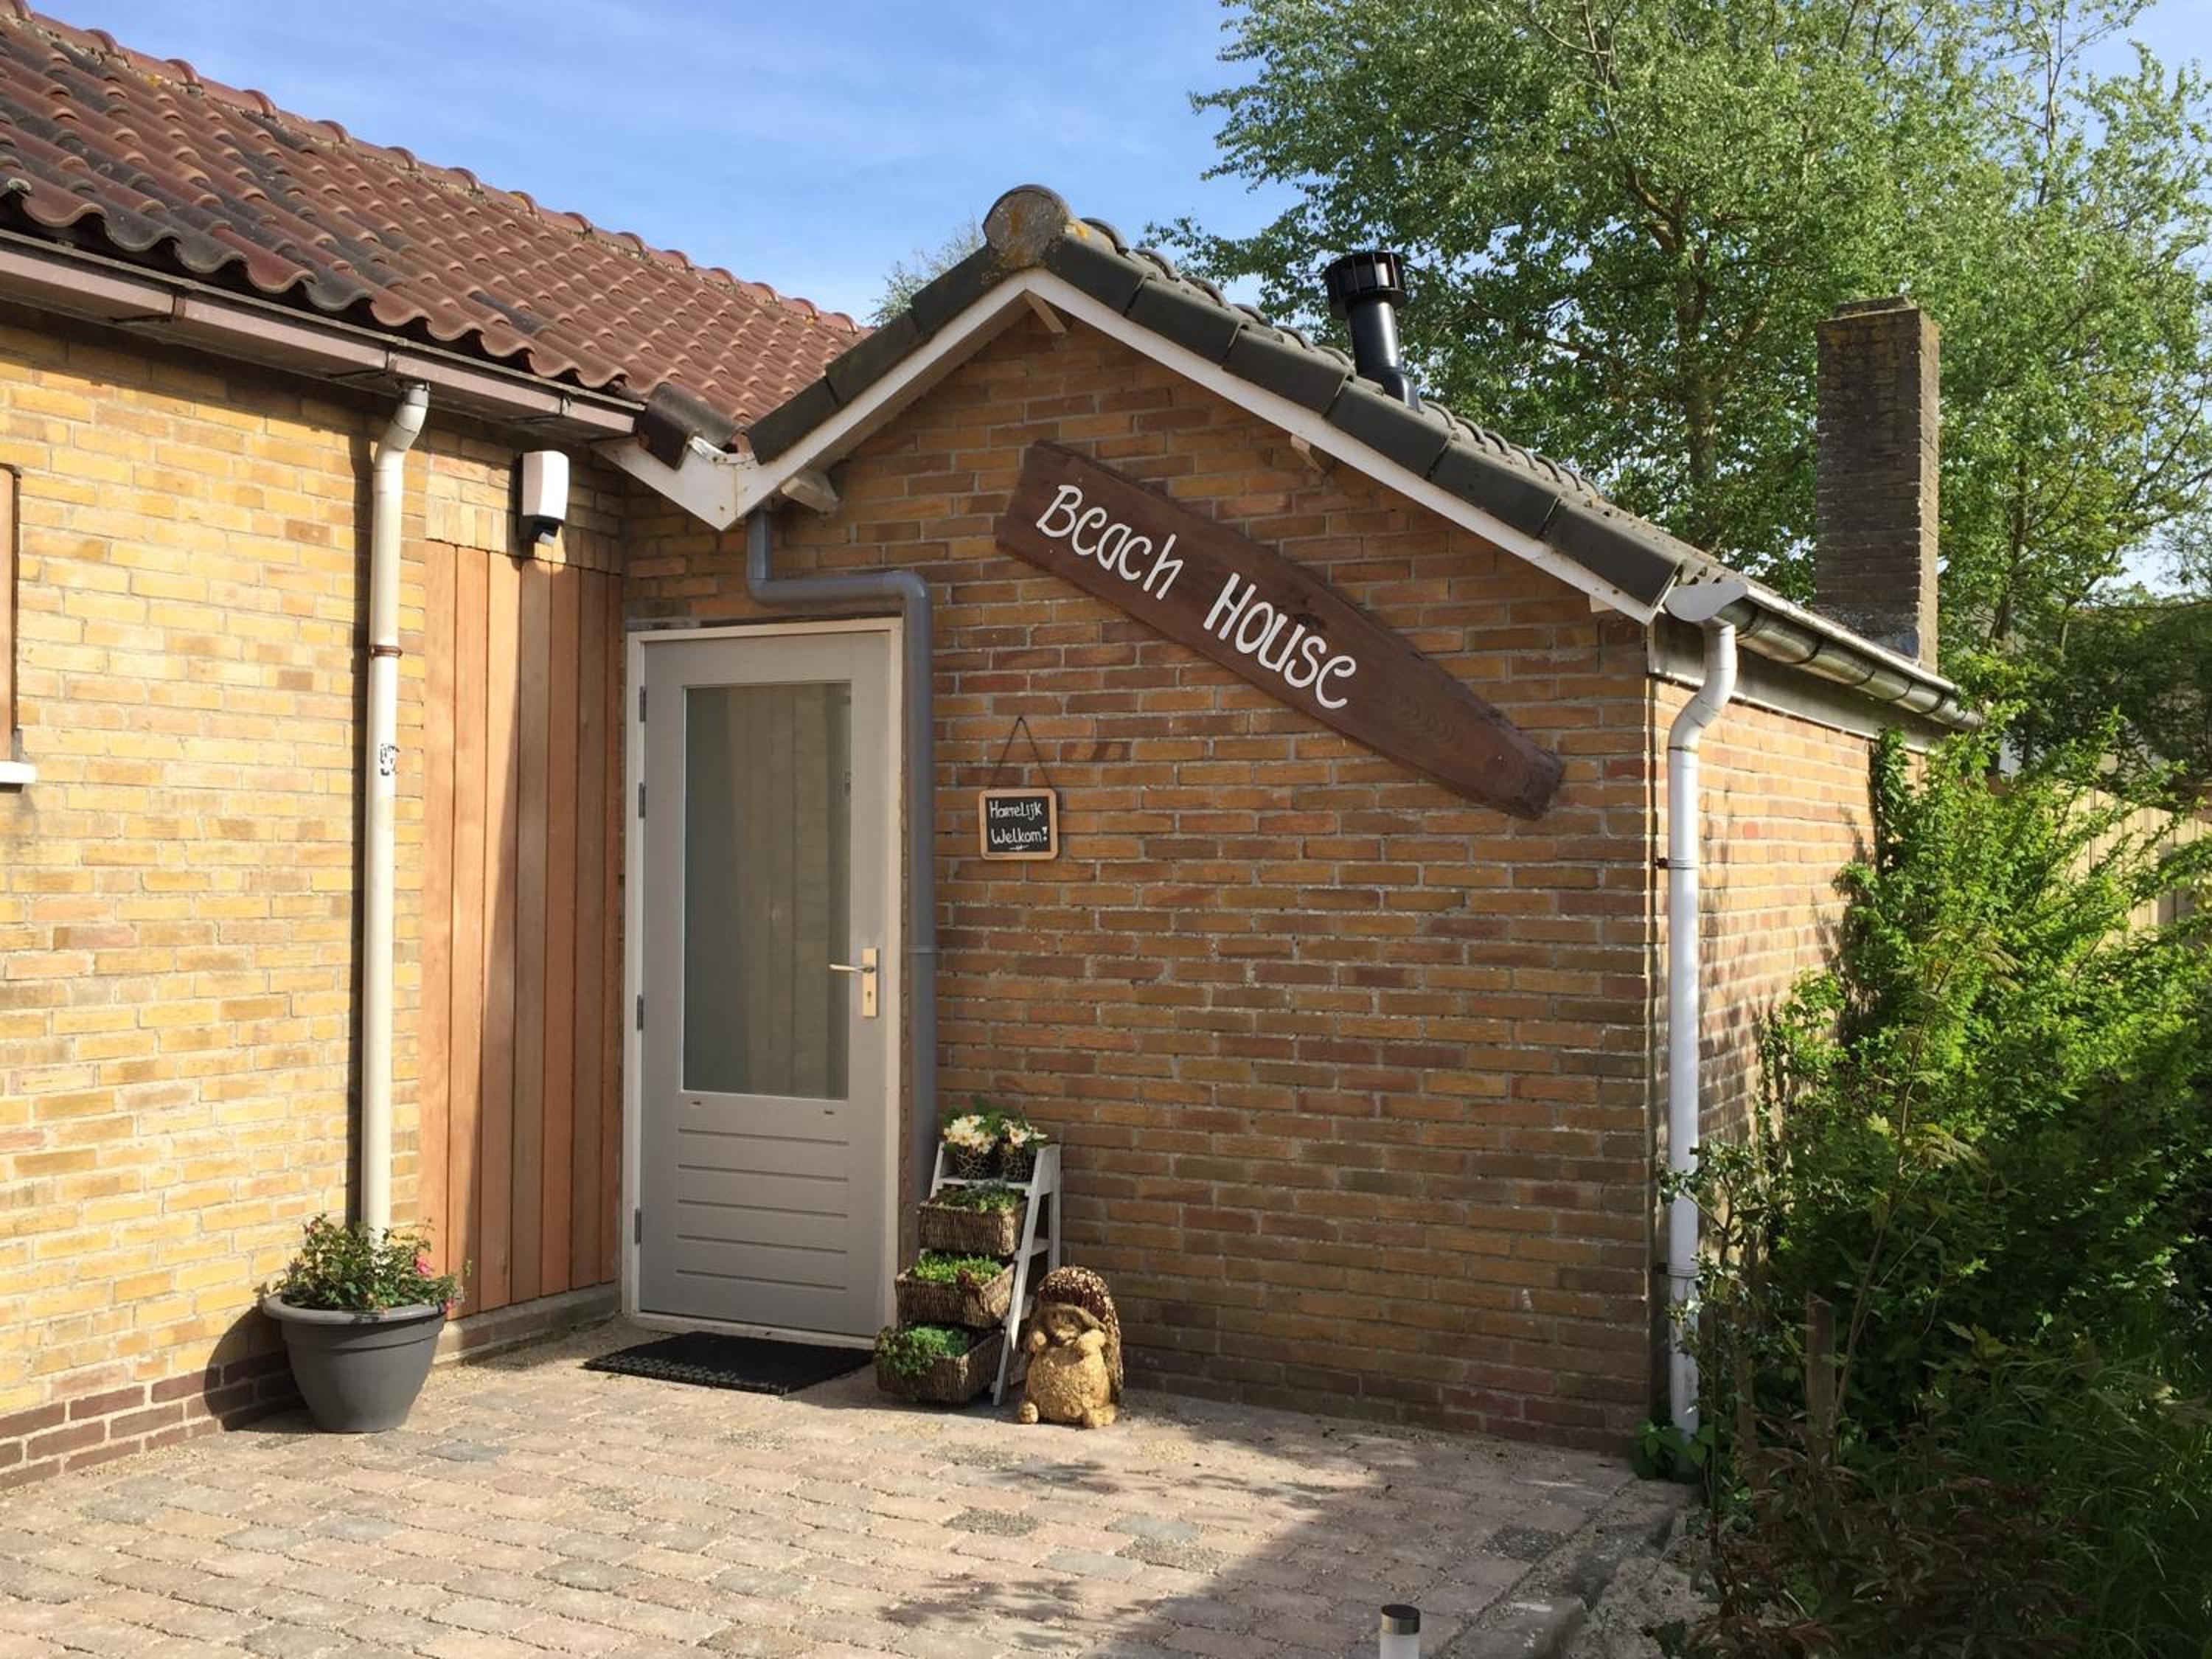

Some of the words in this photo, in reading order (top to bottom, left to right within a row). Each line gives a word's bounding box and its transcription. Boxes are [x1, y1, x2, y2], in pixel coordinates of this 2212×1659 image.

[1036, 484, 1183, 601] Beach
[1203, 573, 1357, 709] House
[990, 827, 1048, 844] Welkom!
